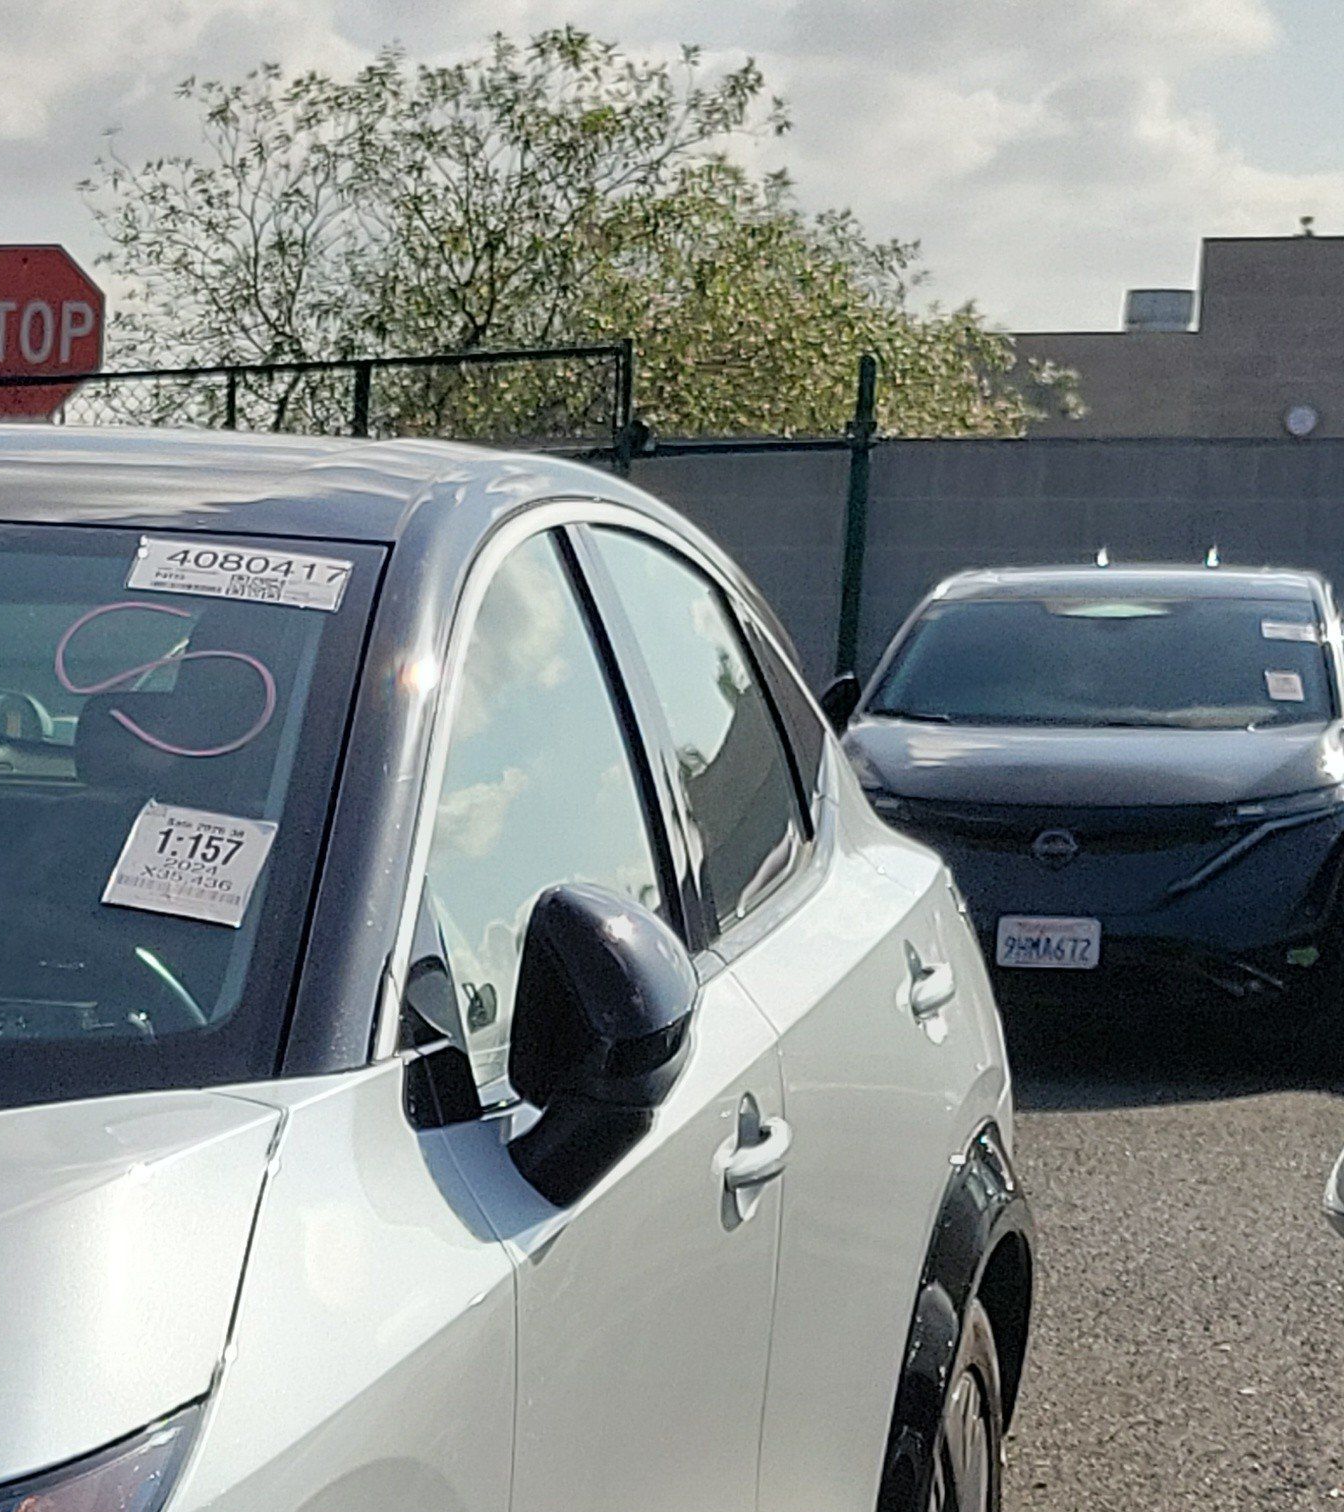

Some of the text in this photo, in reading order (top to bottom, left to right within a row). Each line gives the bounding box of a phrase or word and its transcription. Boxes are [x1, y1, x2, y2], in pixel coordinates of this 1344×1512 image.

[167, 549, 348, 584] 4080417
[157, 827, 245, 866] 1:157
[164, 857, 219, 877] 2024
